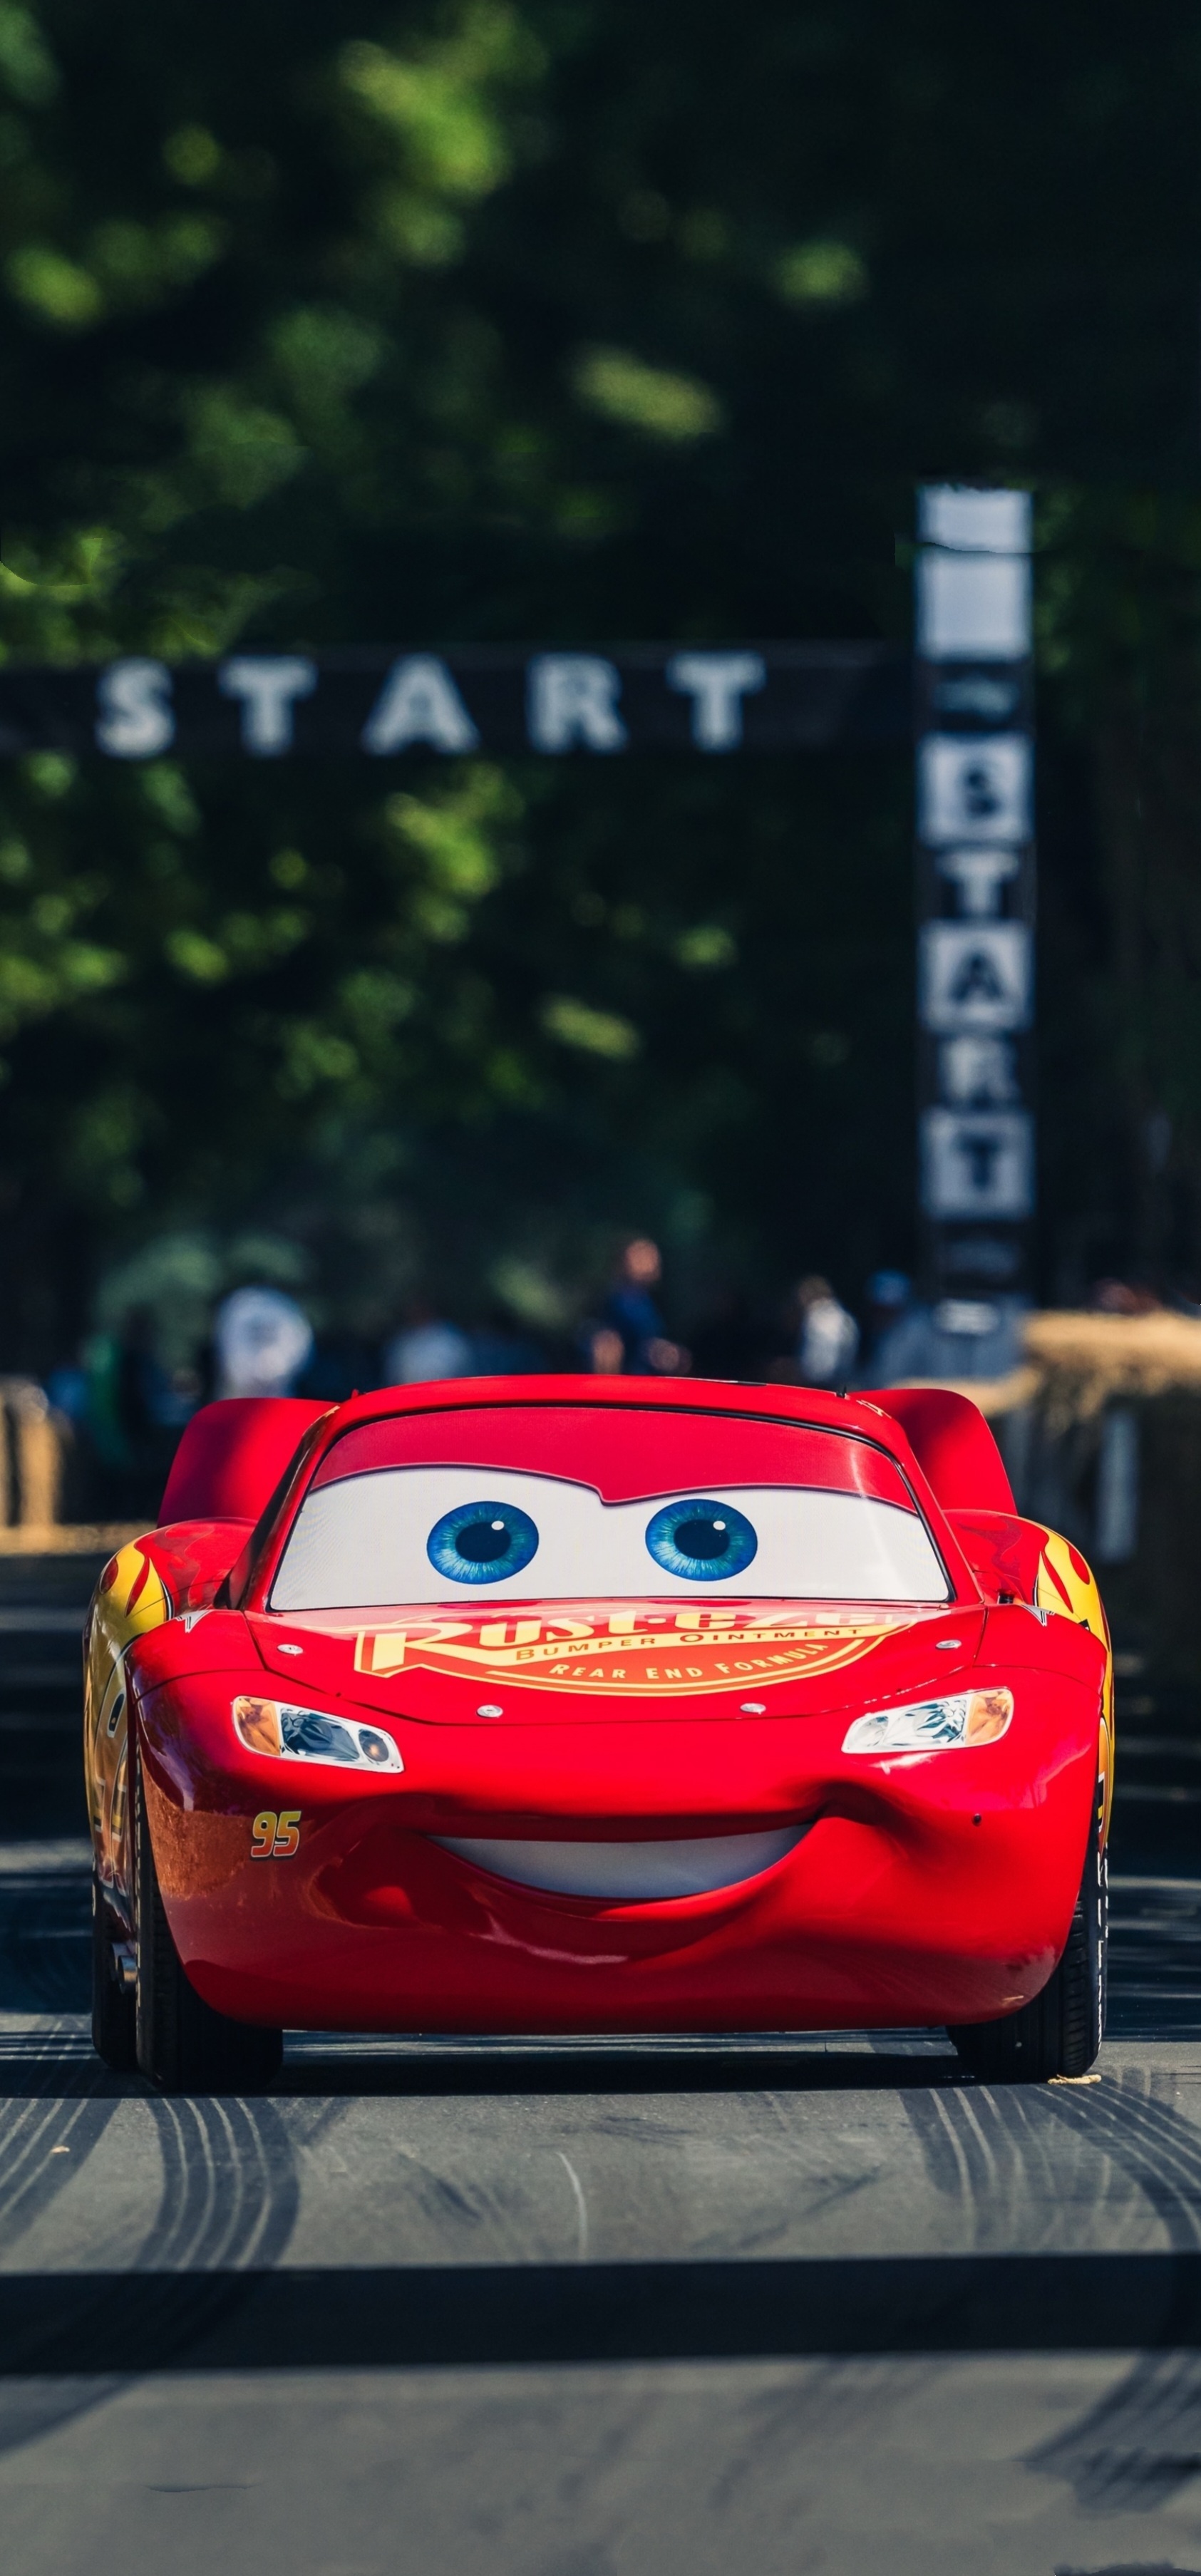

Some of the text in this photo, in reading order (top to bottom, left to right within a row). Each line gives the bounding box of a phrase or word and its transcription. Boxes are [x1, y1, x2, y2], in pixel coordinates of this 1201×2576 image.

[96, 651, 767, 758] START
[515, 1629, 862, 1661] BUMPER OINTMENT
[548, 1643, 829, 1679] REAR END FORMULA
[250, 1810, 302, 1860] 95
